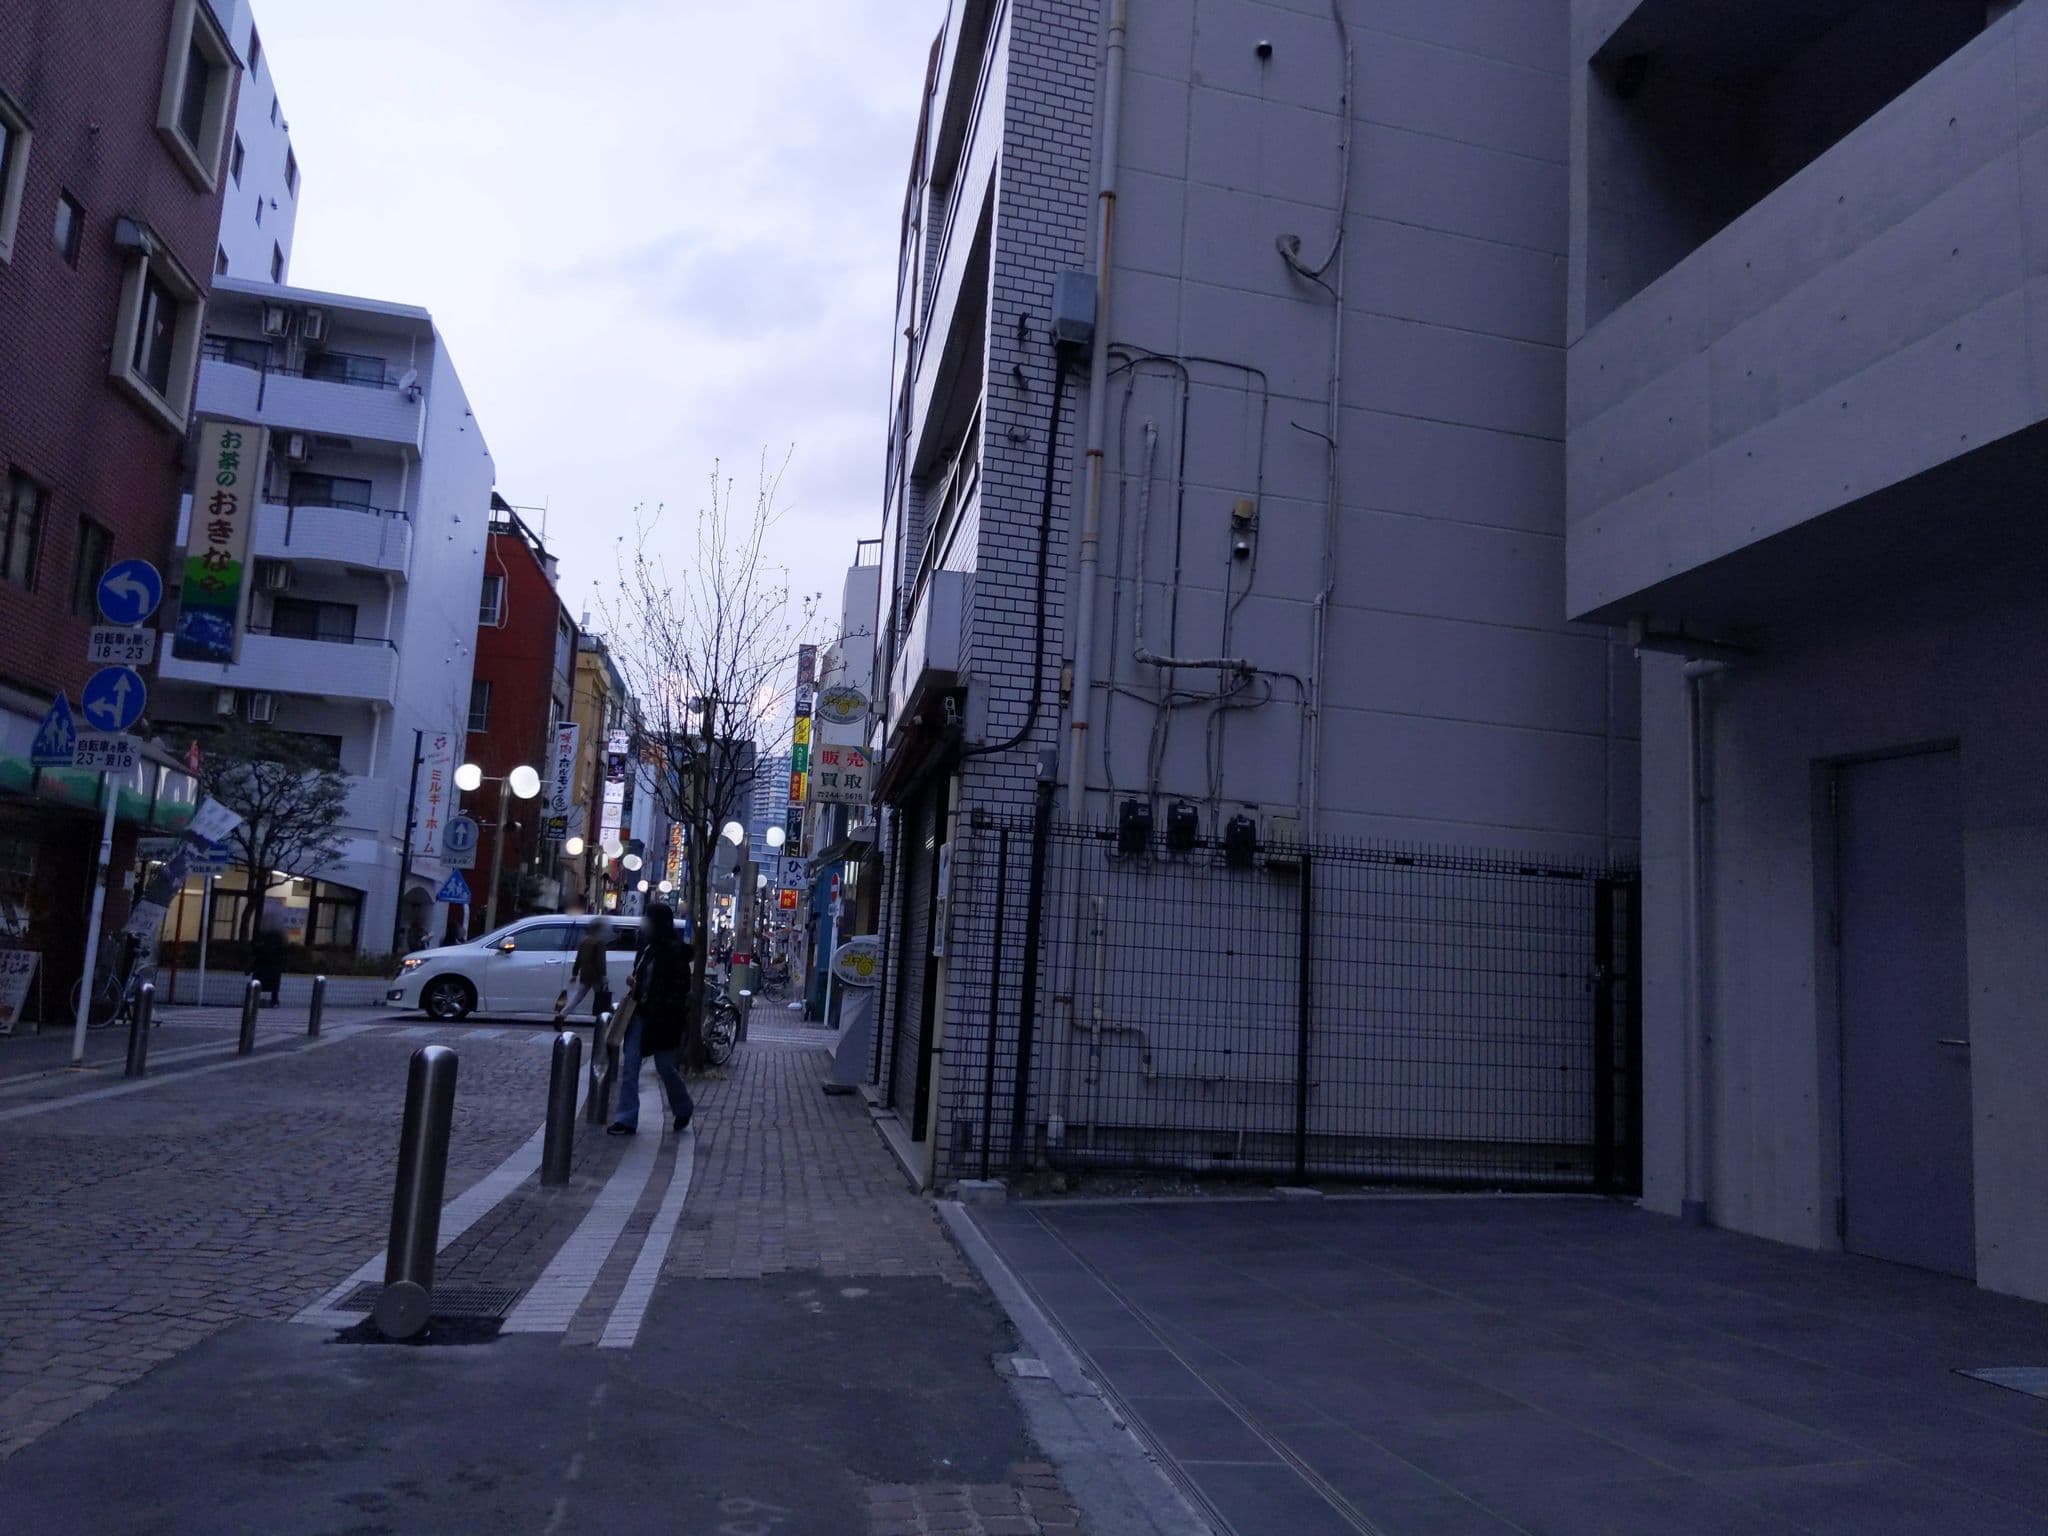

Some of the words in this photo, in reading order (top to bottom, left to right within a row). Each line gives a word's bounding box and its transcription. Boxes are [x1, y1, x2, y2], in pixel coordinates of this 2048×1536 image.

[94, 632, 151, 647] 自転車を除く
[97, 646, 144, 661] 18-23
[78, 739, 137, 755] 自転車を除く
[821, 750, 865, 768] 販売
[821, 772, 862, 789] 買取
[424, 769, 442, 853] ミルキーホーム
